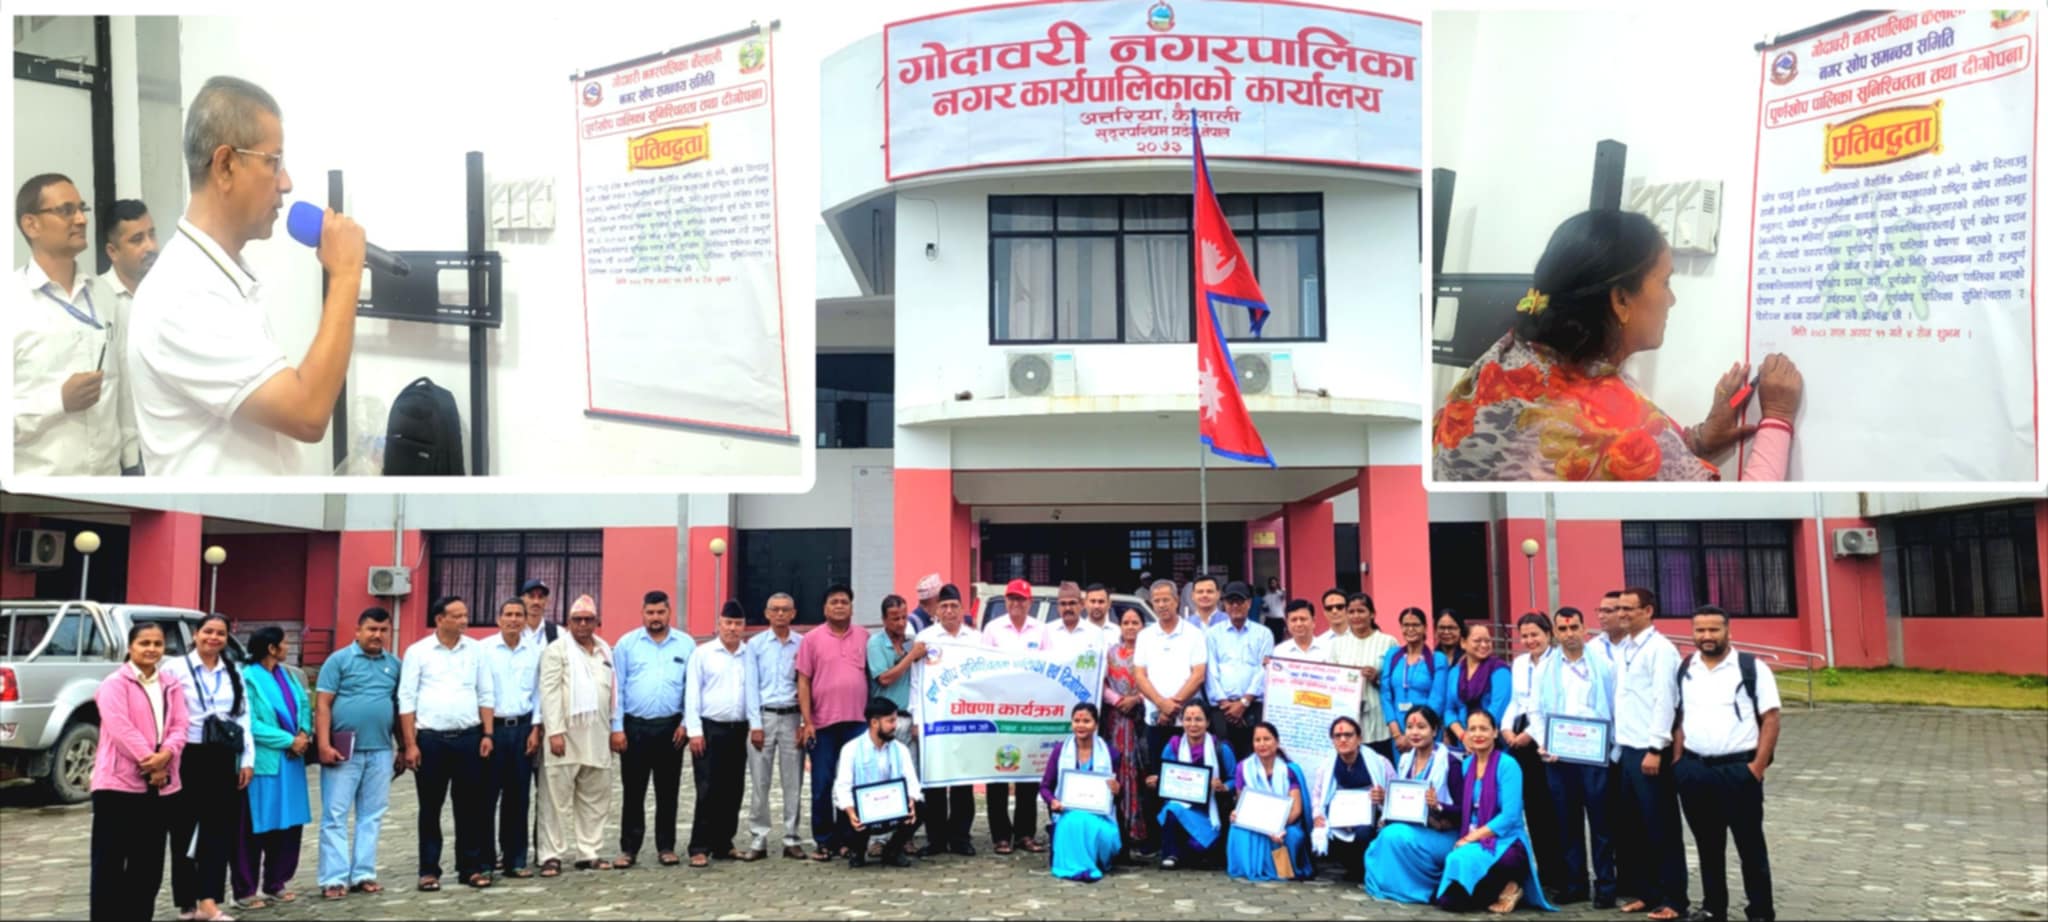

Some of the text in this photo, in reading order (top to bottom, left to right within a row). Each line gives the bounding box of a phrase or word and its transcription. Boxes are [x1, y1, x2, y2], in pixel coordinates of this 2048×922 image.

[898, 20, 1416, 84] गोदावरी नगरपालिका
[932, 65, 1383, 116] नगर कार्यपालिकाको कार्यालय
[950, 699, 1065, 718] घोषणा कार्यक्रम
